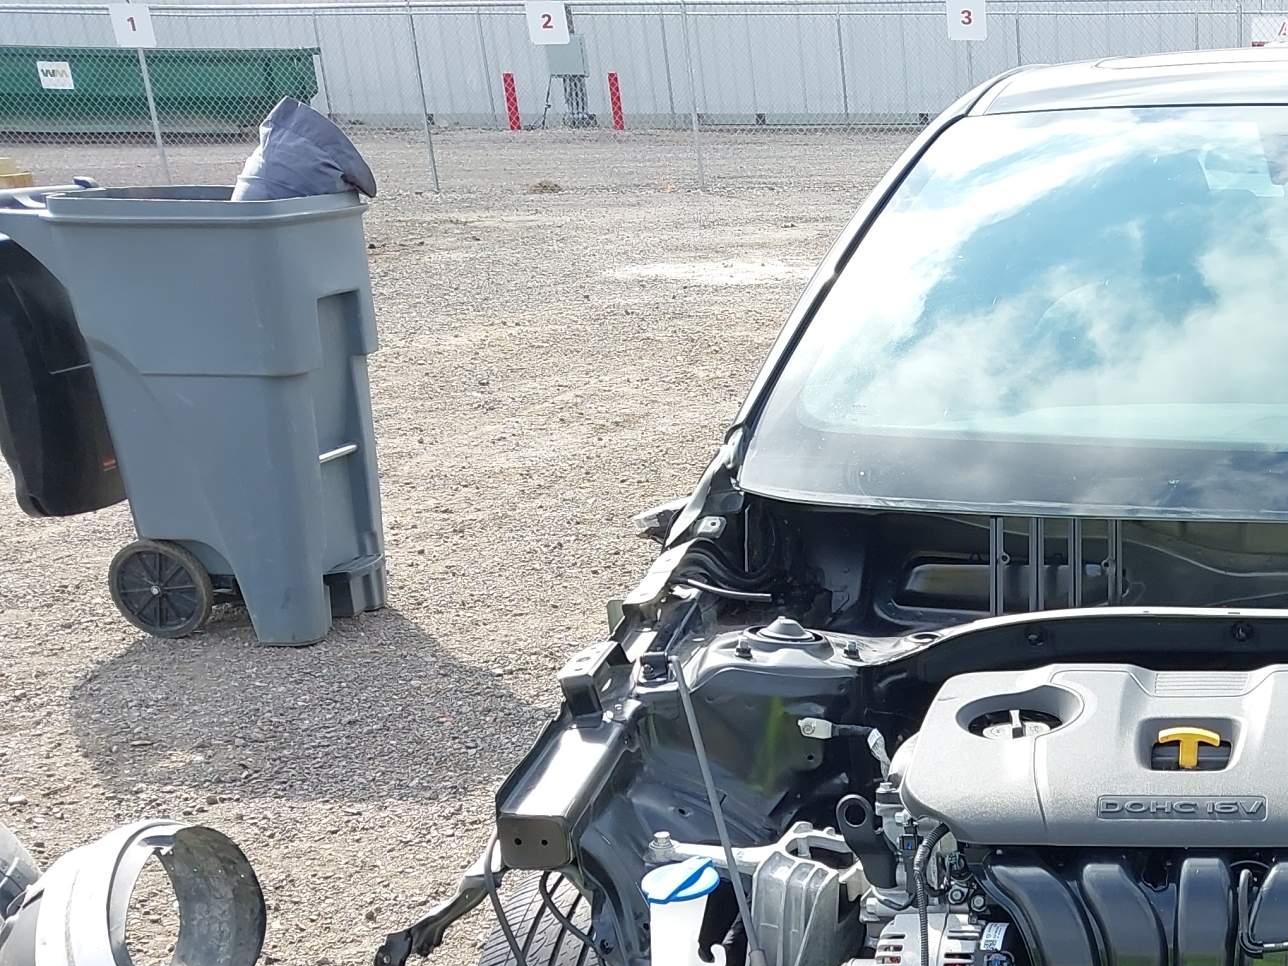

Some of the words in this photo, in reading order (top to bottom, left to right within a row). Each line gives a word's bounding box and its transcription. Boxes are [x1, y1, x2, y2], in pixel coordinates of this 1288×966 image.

[127, 16, 137, 32] 1
[541, 13, 554, 29] 2
[960, 9, 973, 26] 3
[1100, 801, 1198, 814] DOHC
[1207, 800, 1265, 815] 16V
